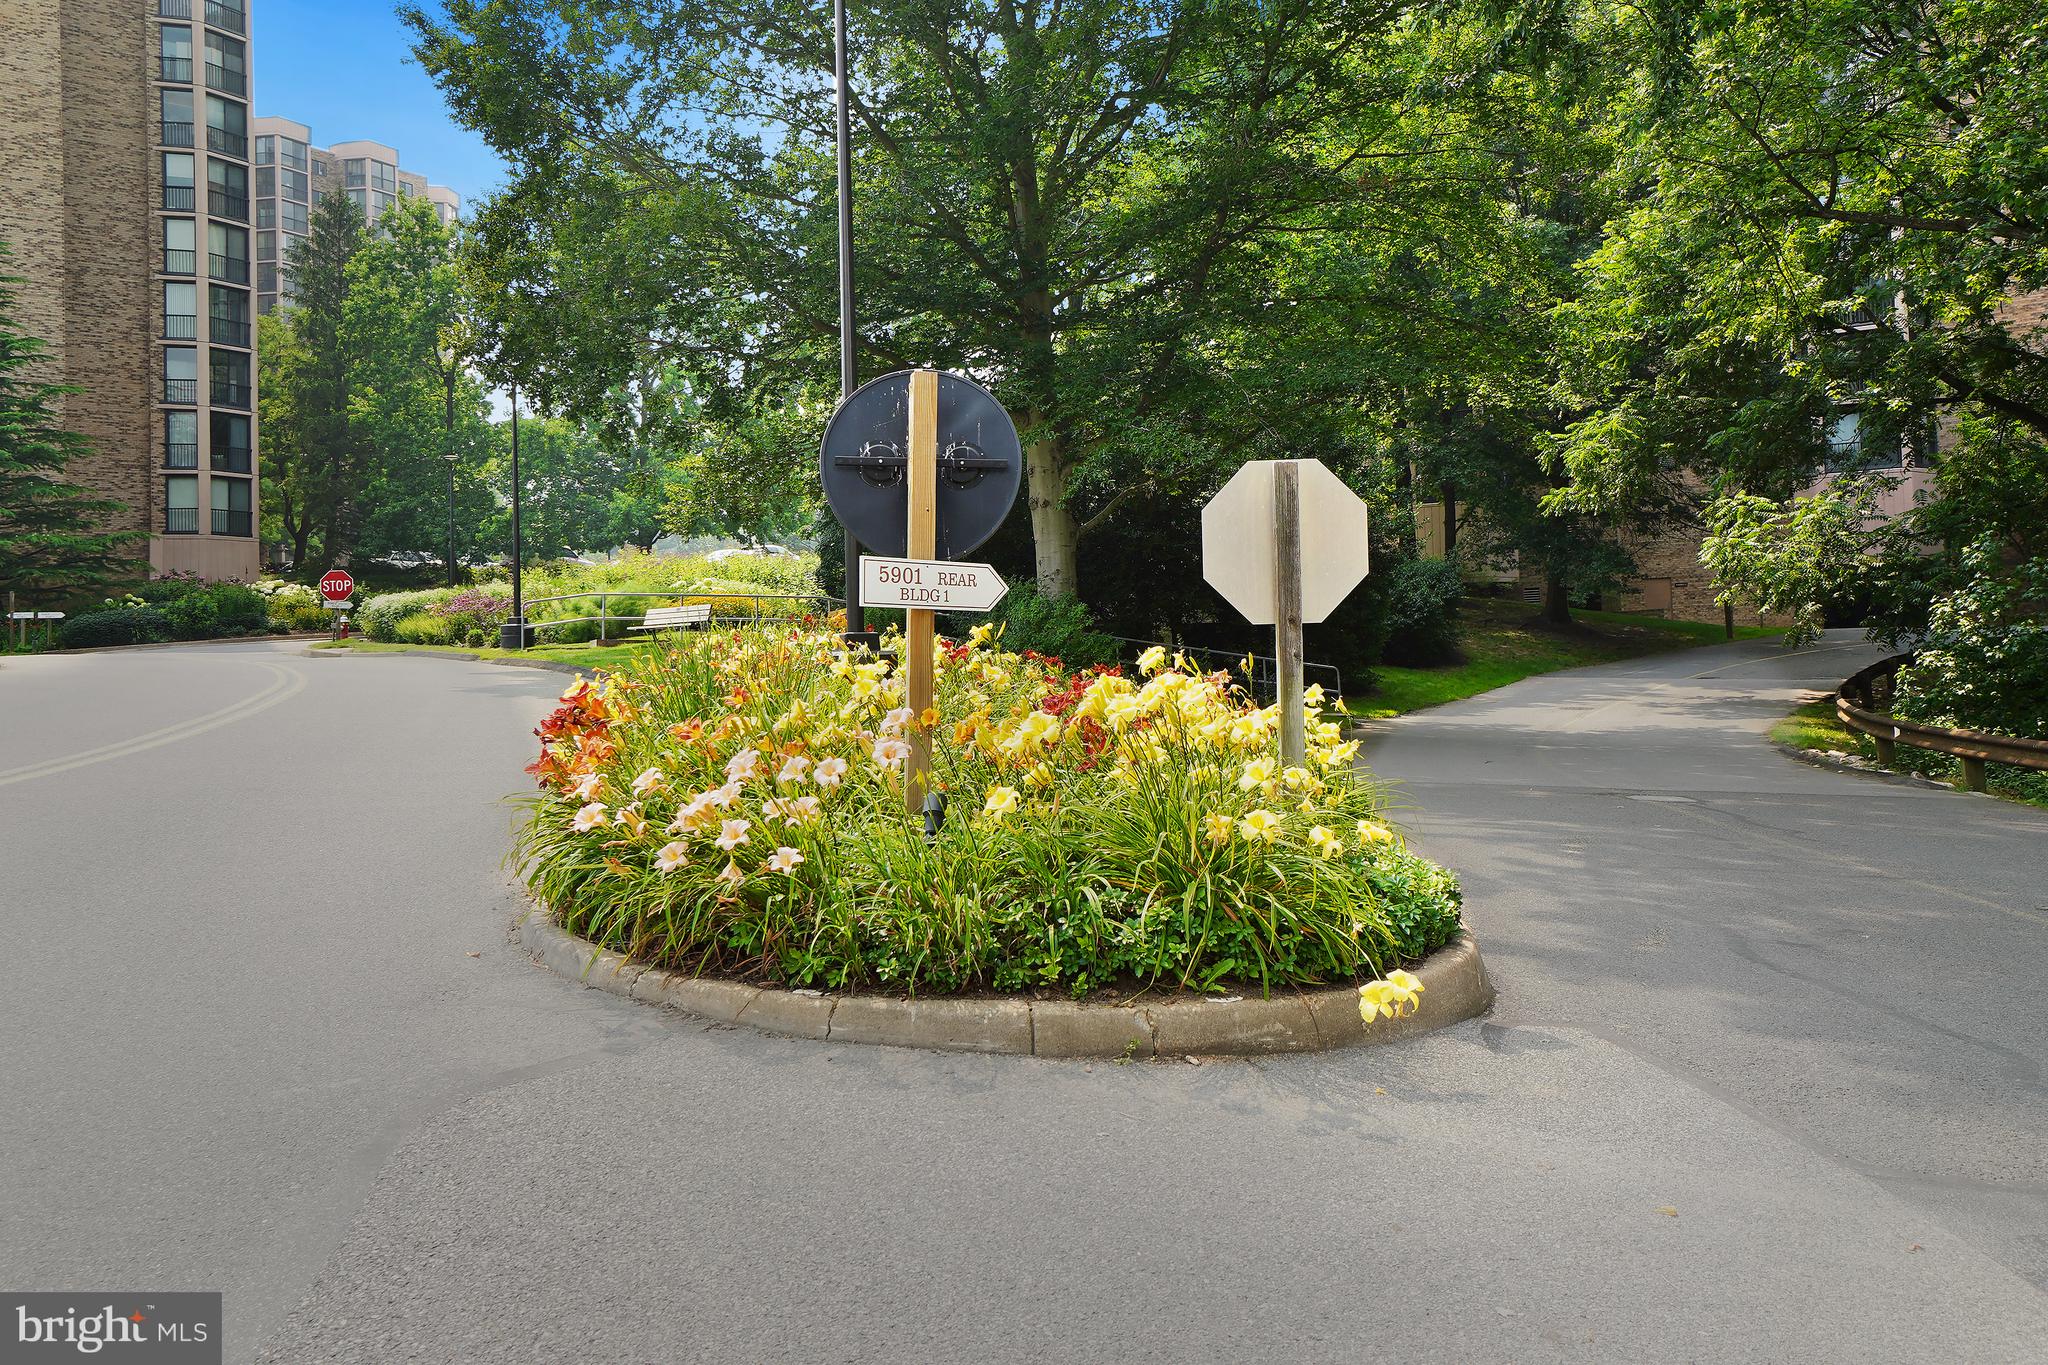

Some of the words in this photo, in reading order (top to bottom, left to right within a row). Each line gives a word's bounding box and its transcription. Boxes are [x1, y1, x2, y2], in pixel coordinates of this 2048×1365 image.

[879, 565, 922, 585] 5901
[937, 572, 977, 587] REAR
[322, 580, 351, 592] STOP
